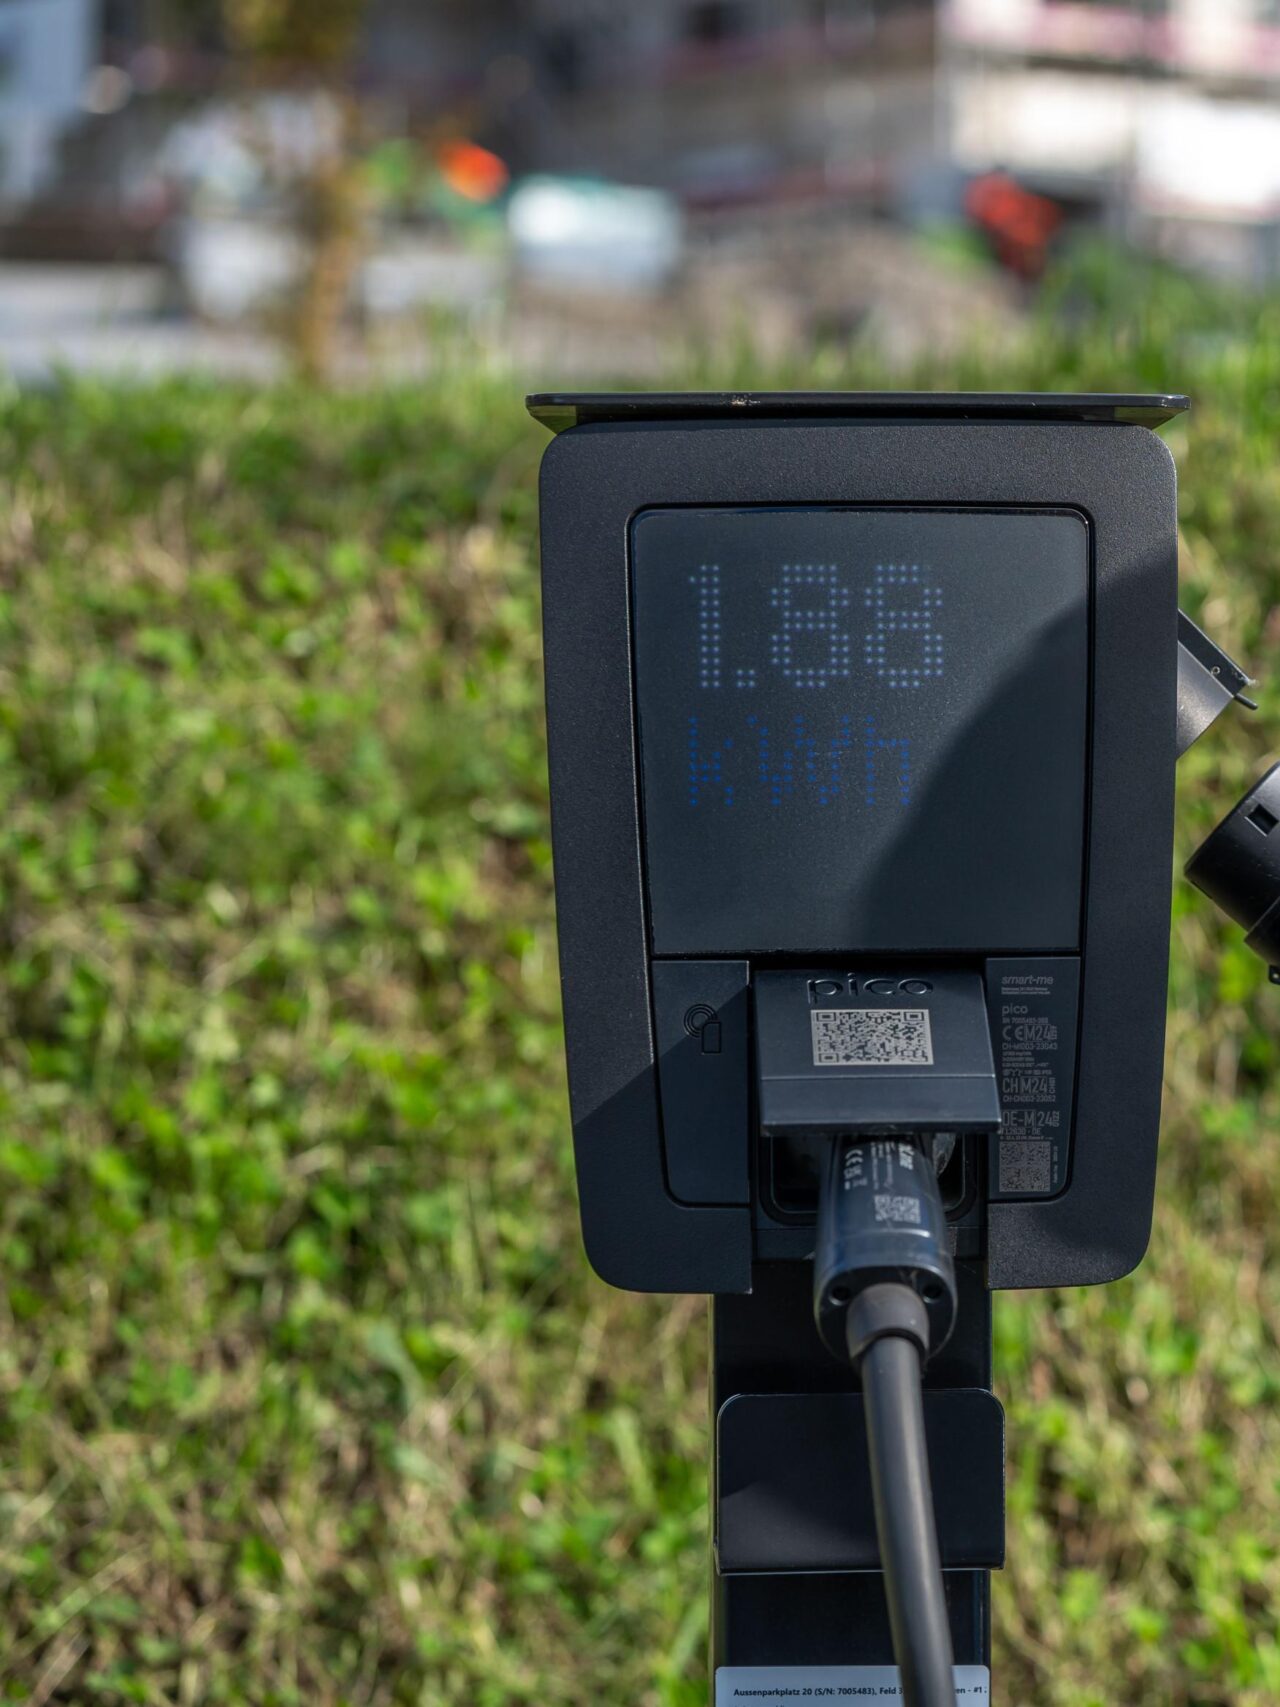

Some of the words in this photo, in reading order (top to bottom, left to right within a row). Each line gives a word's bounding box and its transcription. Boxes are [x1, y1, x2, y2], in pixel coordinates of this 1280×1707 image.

[689, 564, 946, 688] 1.88
[689, 715, 911, 805] kWh
[807, 972, 933, 1004] pico
[1002, 975, 1054, 985] smart-me
[1002, 1003, 1028, 1016] pico
[734, 1688, 800, 1698] Aussenparkplatz
[802, 1688, 812, 1696] 20
[814, 1687, 835, 1697] (S/N:
[838, 1687, 877, 1697] 7005483),
[880, 1687, 896, 1695] Feld
